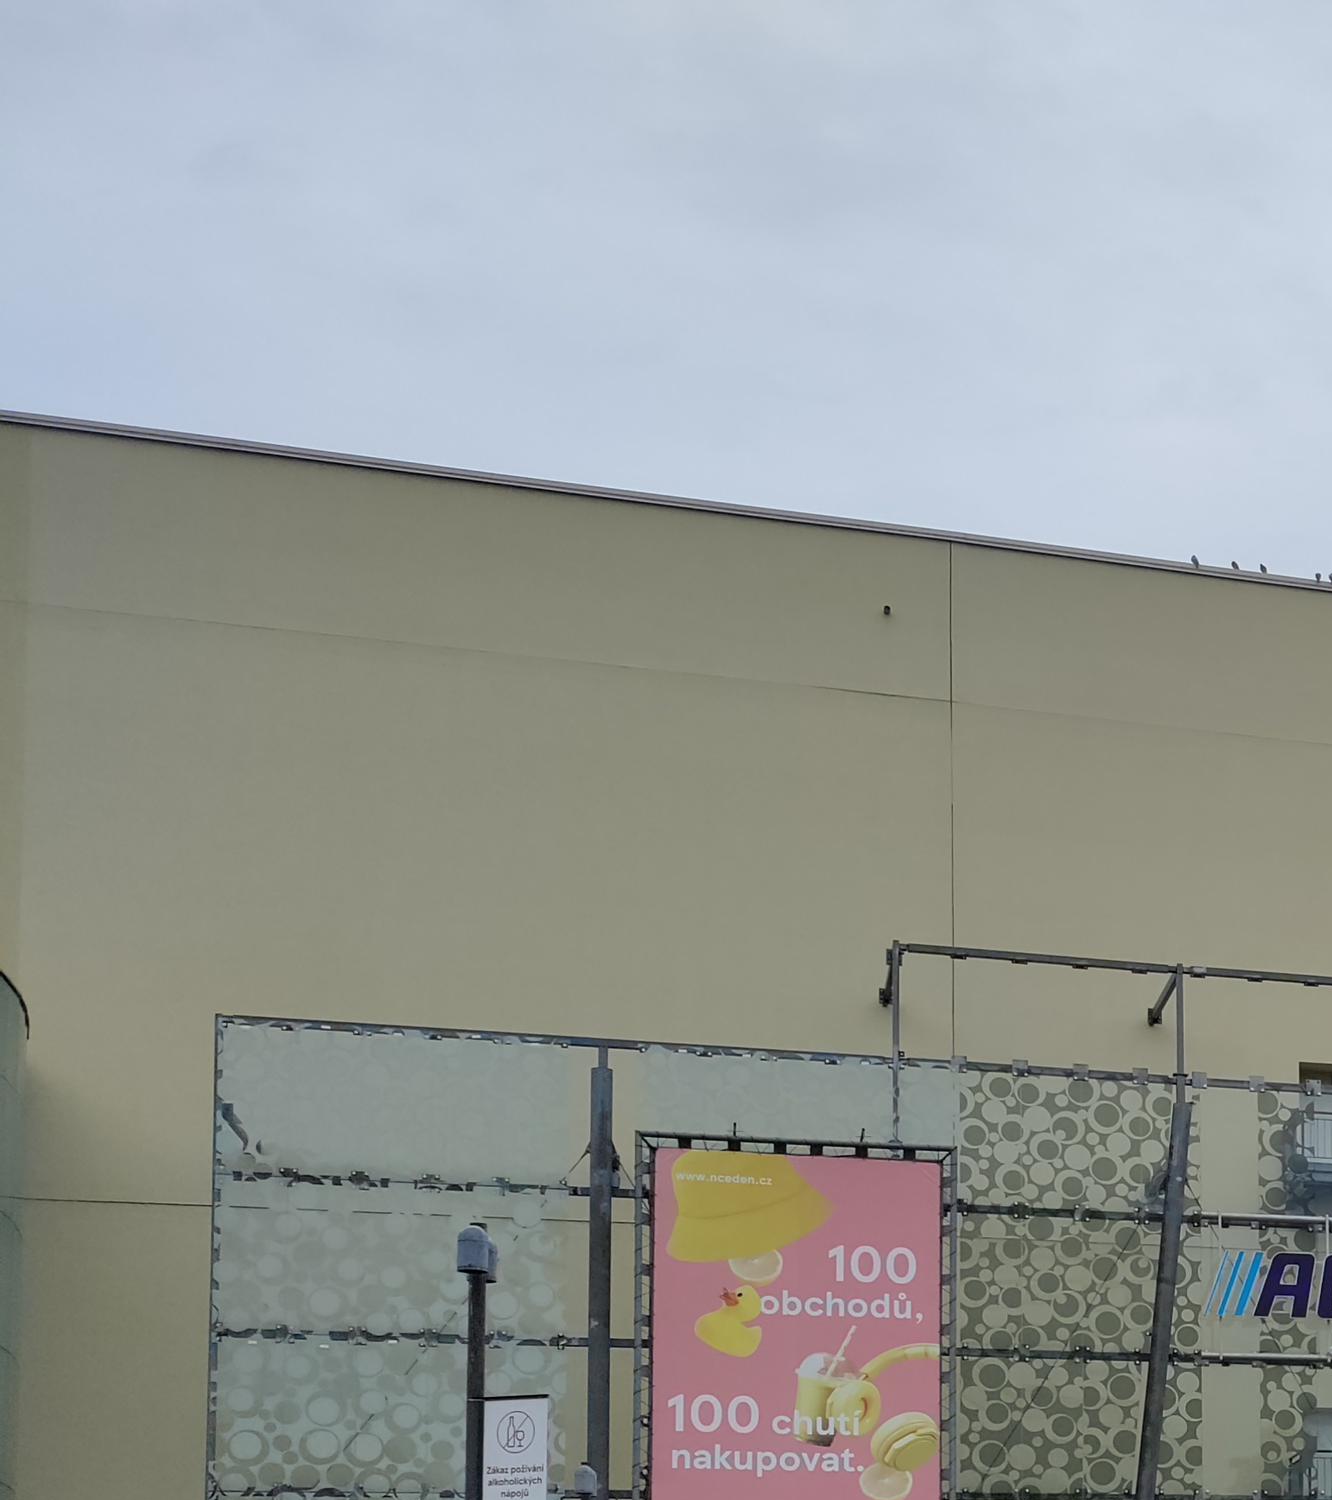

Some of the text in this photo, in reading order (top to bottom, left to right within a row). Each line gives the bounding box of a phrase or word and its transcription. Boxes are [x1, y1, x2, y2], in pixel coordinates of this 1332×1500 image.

[828, 1245, 917, 1284] 100
[760, 1290, 923, 1324] obchodů,
[667, 1393, 863, 1436] 100 chutí
[486, 1466, 508, 1475] Zákaz
[671, 1444, 865, 1478] nakupovat.
[488, 1477, 543, 1486] alkoholických
[501, 1489, 528, 1499] nápojů
